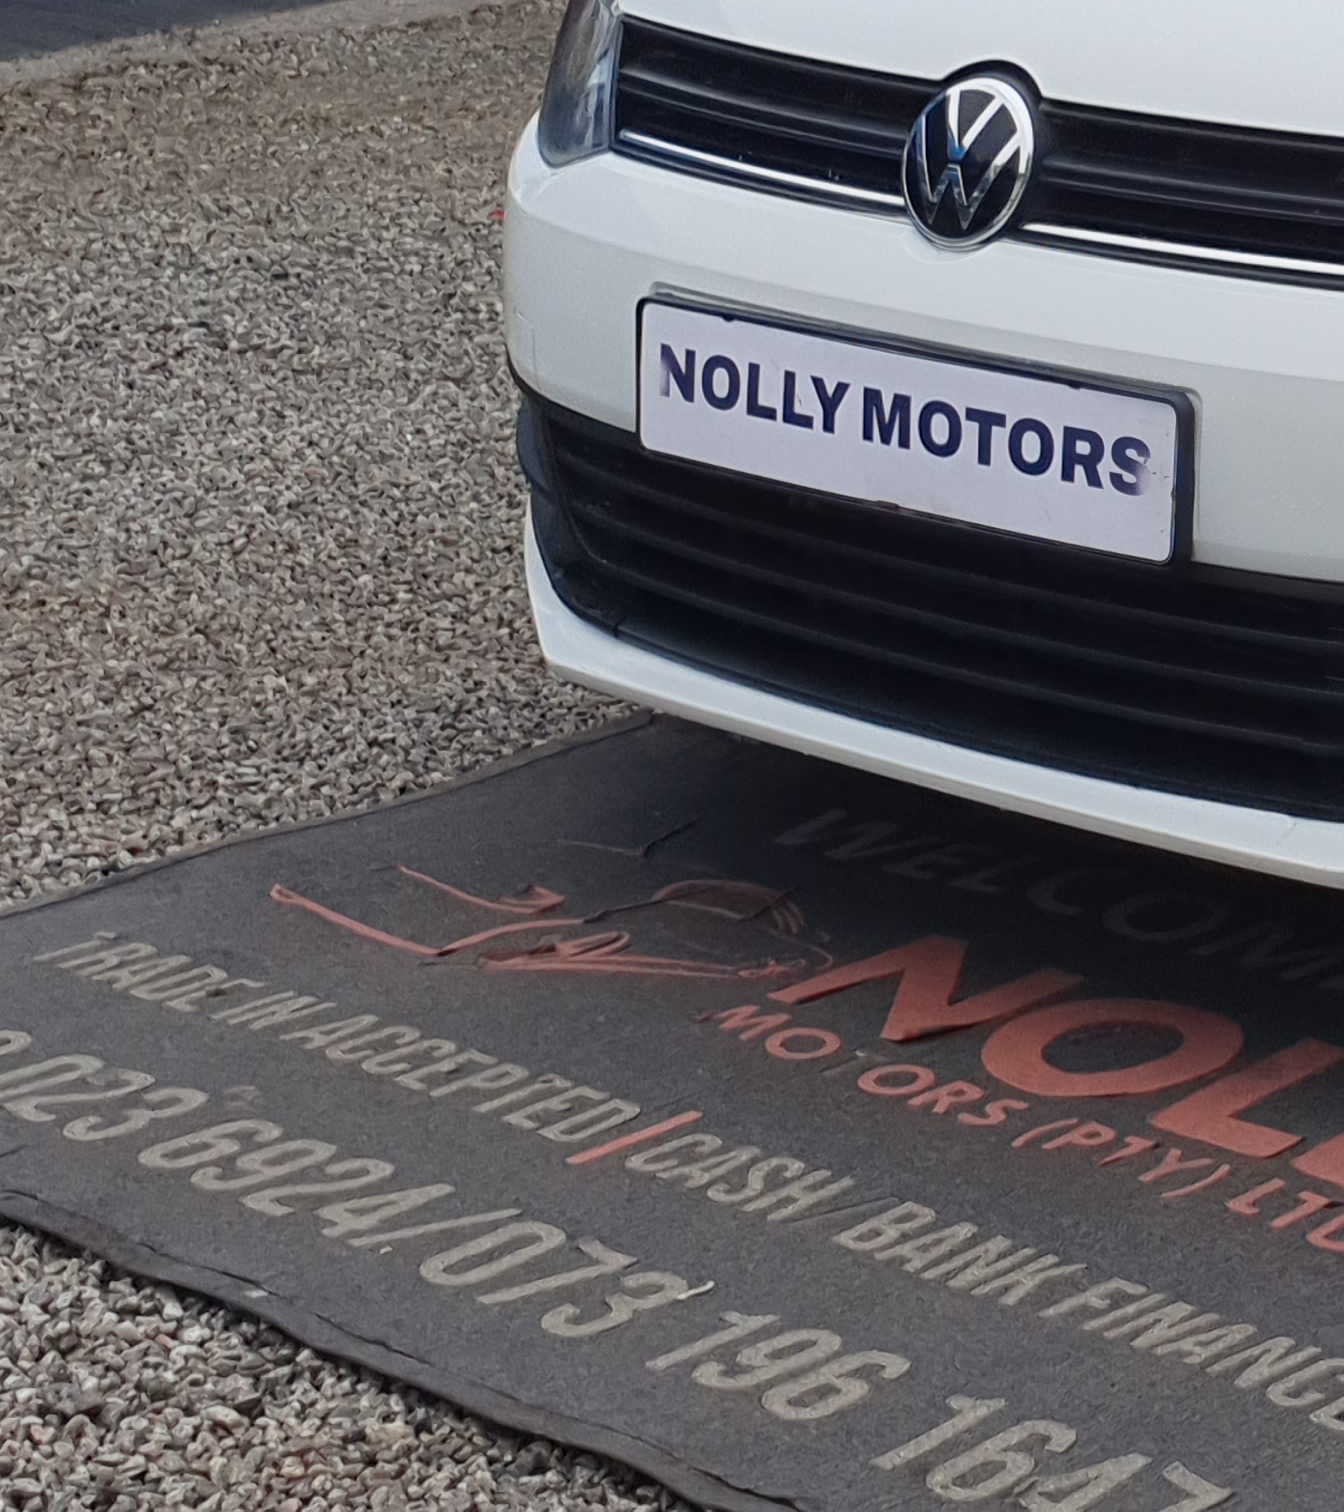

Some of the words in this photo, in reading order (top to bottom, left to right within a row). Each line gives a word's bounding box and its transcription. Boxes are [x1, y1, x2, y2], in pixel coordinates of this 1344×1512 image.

[658, 342, 851, 435] NOLLY
[861, 386, 1152, 496] MOTORS
[33, 932, 267, 1012] TRADE
[208, 990, 338, 1030] IN
[645, 1310, 912, 1420] 196
